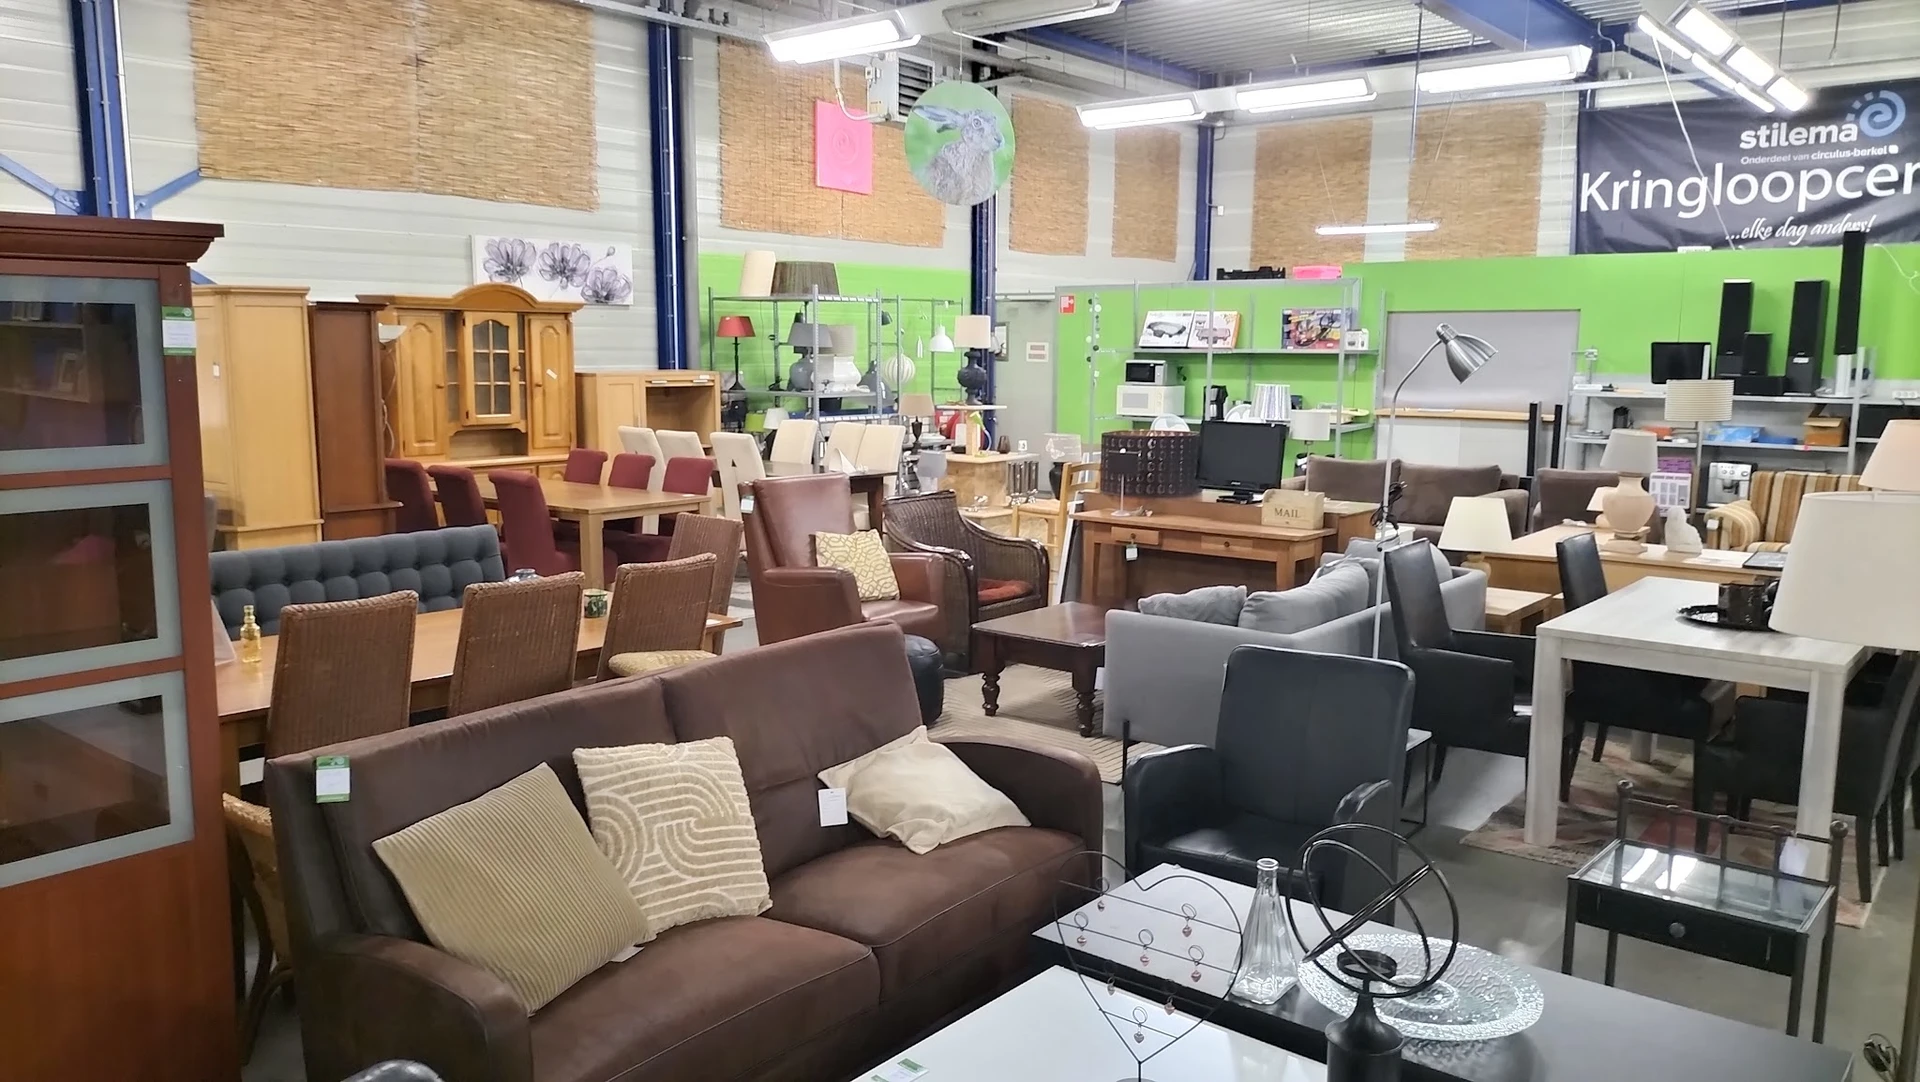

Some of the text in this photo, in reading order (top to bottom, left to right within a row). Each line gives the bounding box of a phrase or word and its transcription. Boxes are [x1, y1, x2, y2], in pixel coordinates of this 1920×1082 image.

[1739, 122, 1859, 149] stilema
[1740, 153, 1791, 165] Onderdeel
[1793, 154, 1810, 162] van
[1775, 216, 1809, 246] dag
[1274, 507, 1301, 518] MAIL
